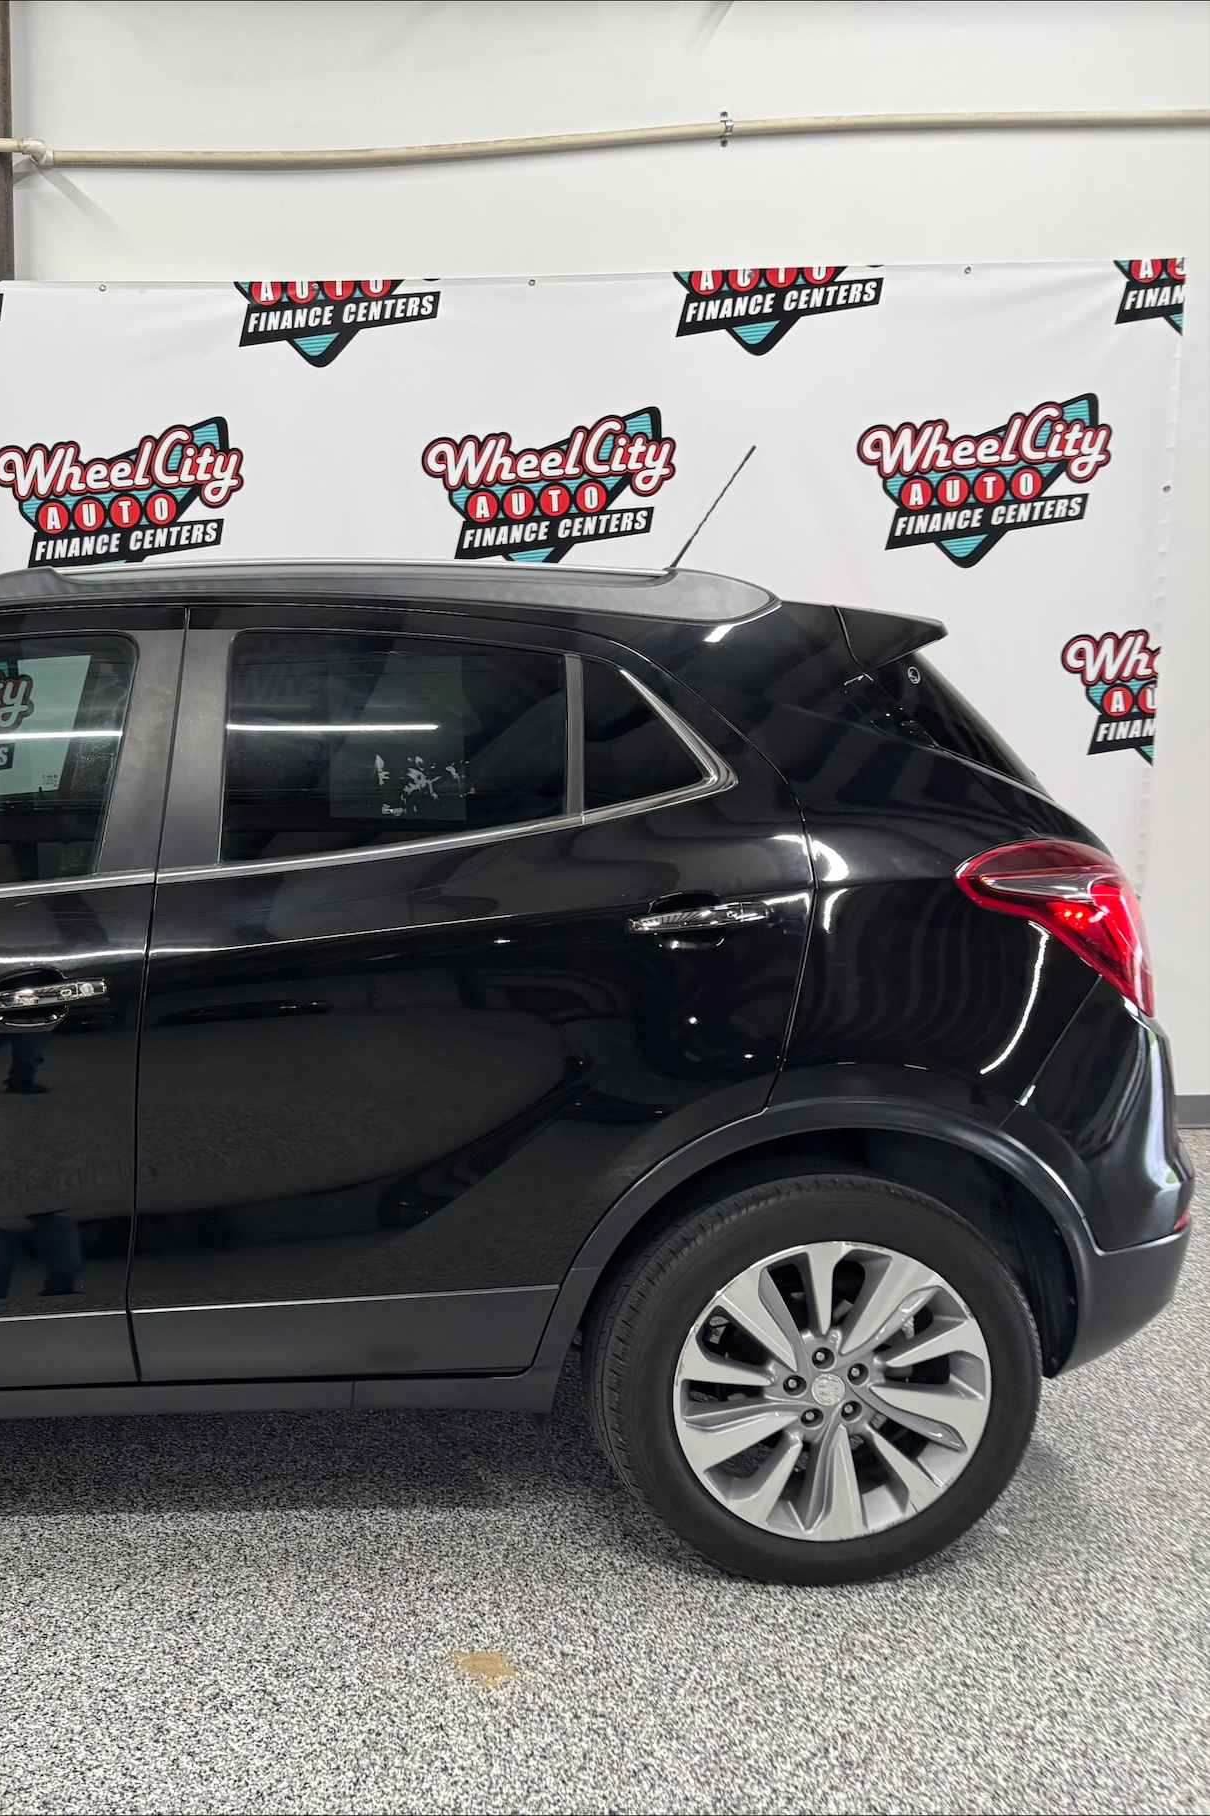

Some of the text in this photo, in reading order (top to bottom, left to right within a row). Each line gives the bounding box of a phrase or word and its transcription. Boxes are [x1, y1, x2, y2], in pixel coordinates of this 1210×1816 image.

[247, 295, 435, 334] FINANCE CENTERS
[685, 281, 877, 323] FINANCE CENTERS
[475, 485, 599, 519] AUTO
[908, 472, 1035, 507] AUTO
[46, 496, 169, 531] AUTO
[462, 510, 648, 550] FINANCE CENTERS
[894, 497, 1082, 537] FINANCE CENTERS
[34, 522, 218, 561] FINANCE CENTERS
